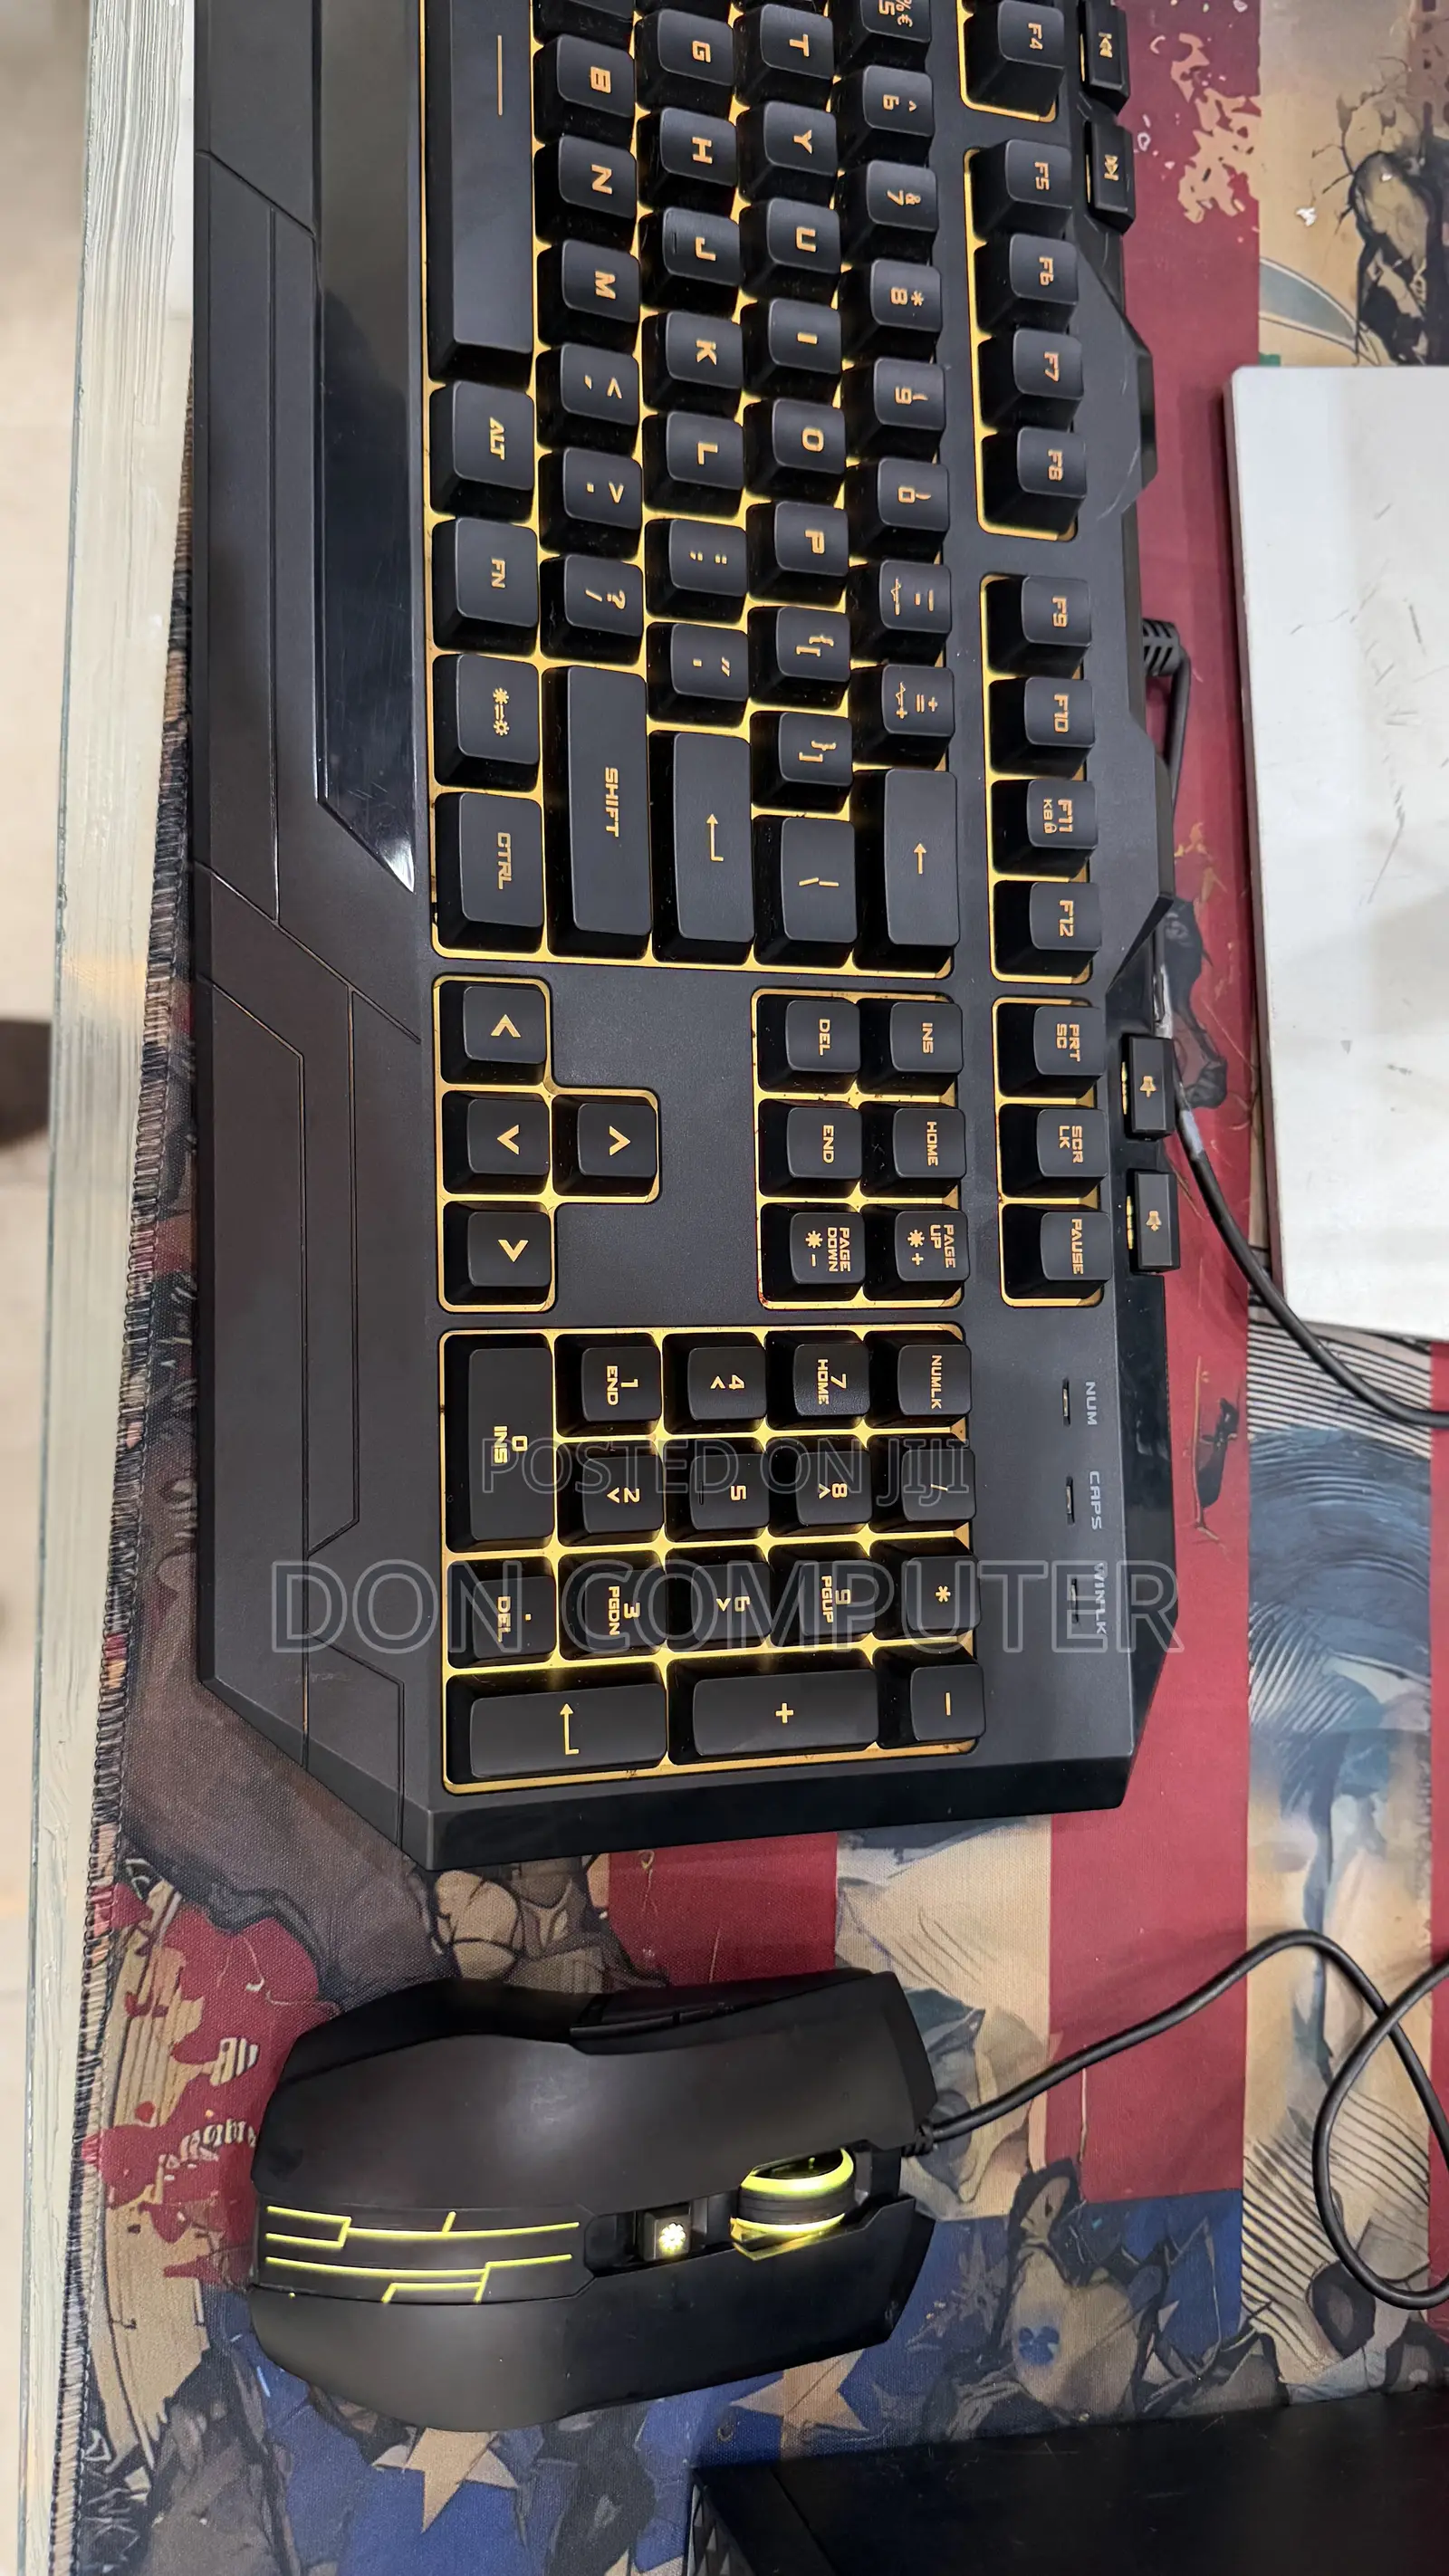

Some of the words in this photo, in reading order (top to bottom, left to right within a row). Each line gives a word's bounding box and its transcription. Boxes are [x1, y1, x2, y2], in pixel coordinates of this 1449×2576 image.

[789, 34, 810, 57] T
[1028, 23, 1042, 50] F4
[692, 40, 711, 63] G
[590, 66, 611, 94] B
[882, 94, 899, 110] 6
[691, 137, 713, 165] H
[793, 129, 812, 154] Y
[590, 164, 612, 195] N
[1034, 161, 1050, 190] F5
[887, 189, 905, 206] 7
[695, 236, 716, 262] J
[795, 227, 817, 253] U
[594, 270, 616, 300] M
[1039, 256, 1054, 286] F6
[890, 287, 908, 305] 8
[696, 339, 717, 366] K
[797, 331, 818, 345] I
[1043, 351, 1060, 382] F7
[895, 387, 913, 405] 9
[489, 417, 505, 461] ALT
[696, 441, 718, 465] L
[801, 427, 824, 452] O
[1047, 449, 1063, 481] F8
[897, 486, 916, 503] 0
[804, 529, 825, 554] P
[491, 557, 506, 589] FN
[1051, 596, 1068, 627] F9
[1053, 694, 1070, 733] F10
[604, 767, 619, 838] SHIFT
[1042, 799, 1053, 821] KB
[1057, 799, 1073, 833] F11
[497, 832, 512, 890] CTRL
[1059, 899, 1074, 937] F12
[819, 1019, 830, 1056] DEL
[922, 1022, 934, 1054] INS
[1056, 1023, 1067, 1049] SC
[1069, 1023, 1080, 1061] PRT
[822, 1125, 834, 1164] END
[926, 1121, 938, 1166] HOME
[1059, 1125, 1070, 1149] LK
[1071, 1125, 1083, 1164] SCR
[827, 1227, 838, 1272] DOWN
[839, 1227, 850, 1272] PAGE
[929, 1224, 942, 1250] UP
[943, 1224, 955, 1268] PAGE
[1070, 1219, 1083, 1274] PAUSE
[606, 1365, 619, 1406] END
[620, 1377, 638, 1388] 1
[727, 1374, 745, 1390] 4
[817, 1358, 829, 1405] HOME
[830, 1374, 847, 1389] 7
[930, 1355, 942, 1410] NUMLK
[1085, 1380, 1099, 1426] NUM
[493, 1425, 508, 1464] INS
[511, 1435, 528, 1452] 0
[623, 1487, 640, 1503] 2
[730, 1484, 746, 1501] 5
[831, 1482, 848, 1499] 8
[1089, 1470, 1103, 1530] CAPS
[608, 1585, 620, 1636] PGDN
[623, 1602, 640, 1619] 3
[734, 1595, 751, 1613] 6
[820, 1575, 834, 1623] PGUP
[834, 1588, 851, 1605] 9
[496, 1595, 512, 1643] DEL
